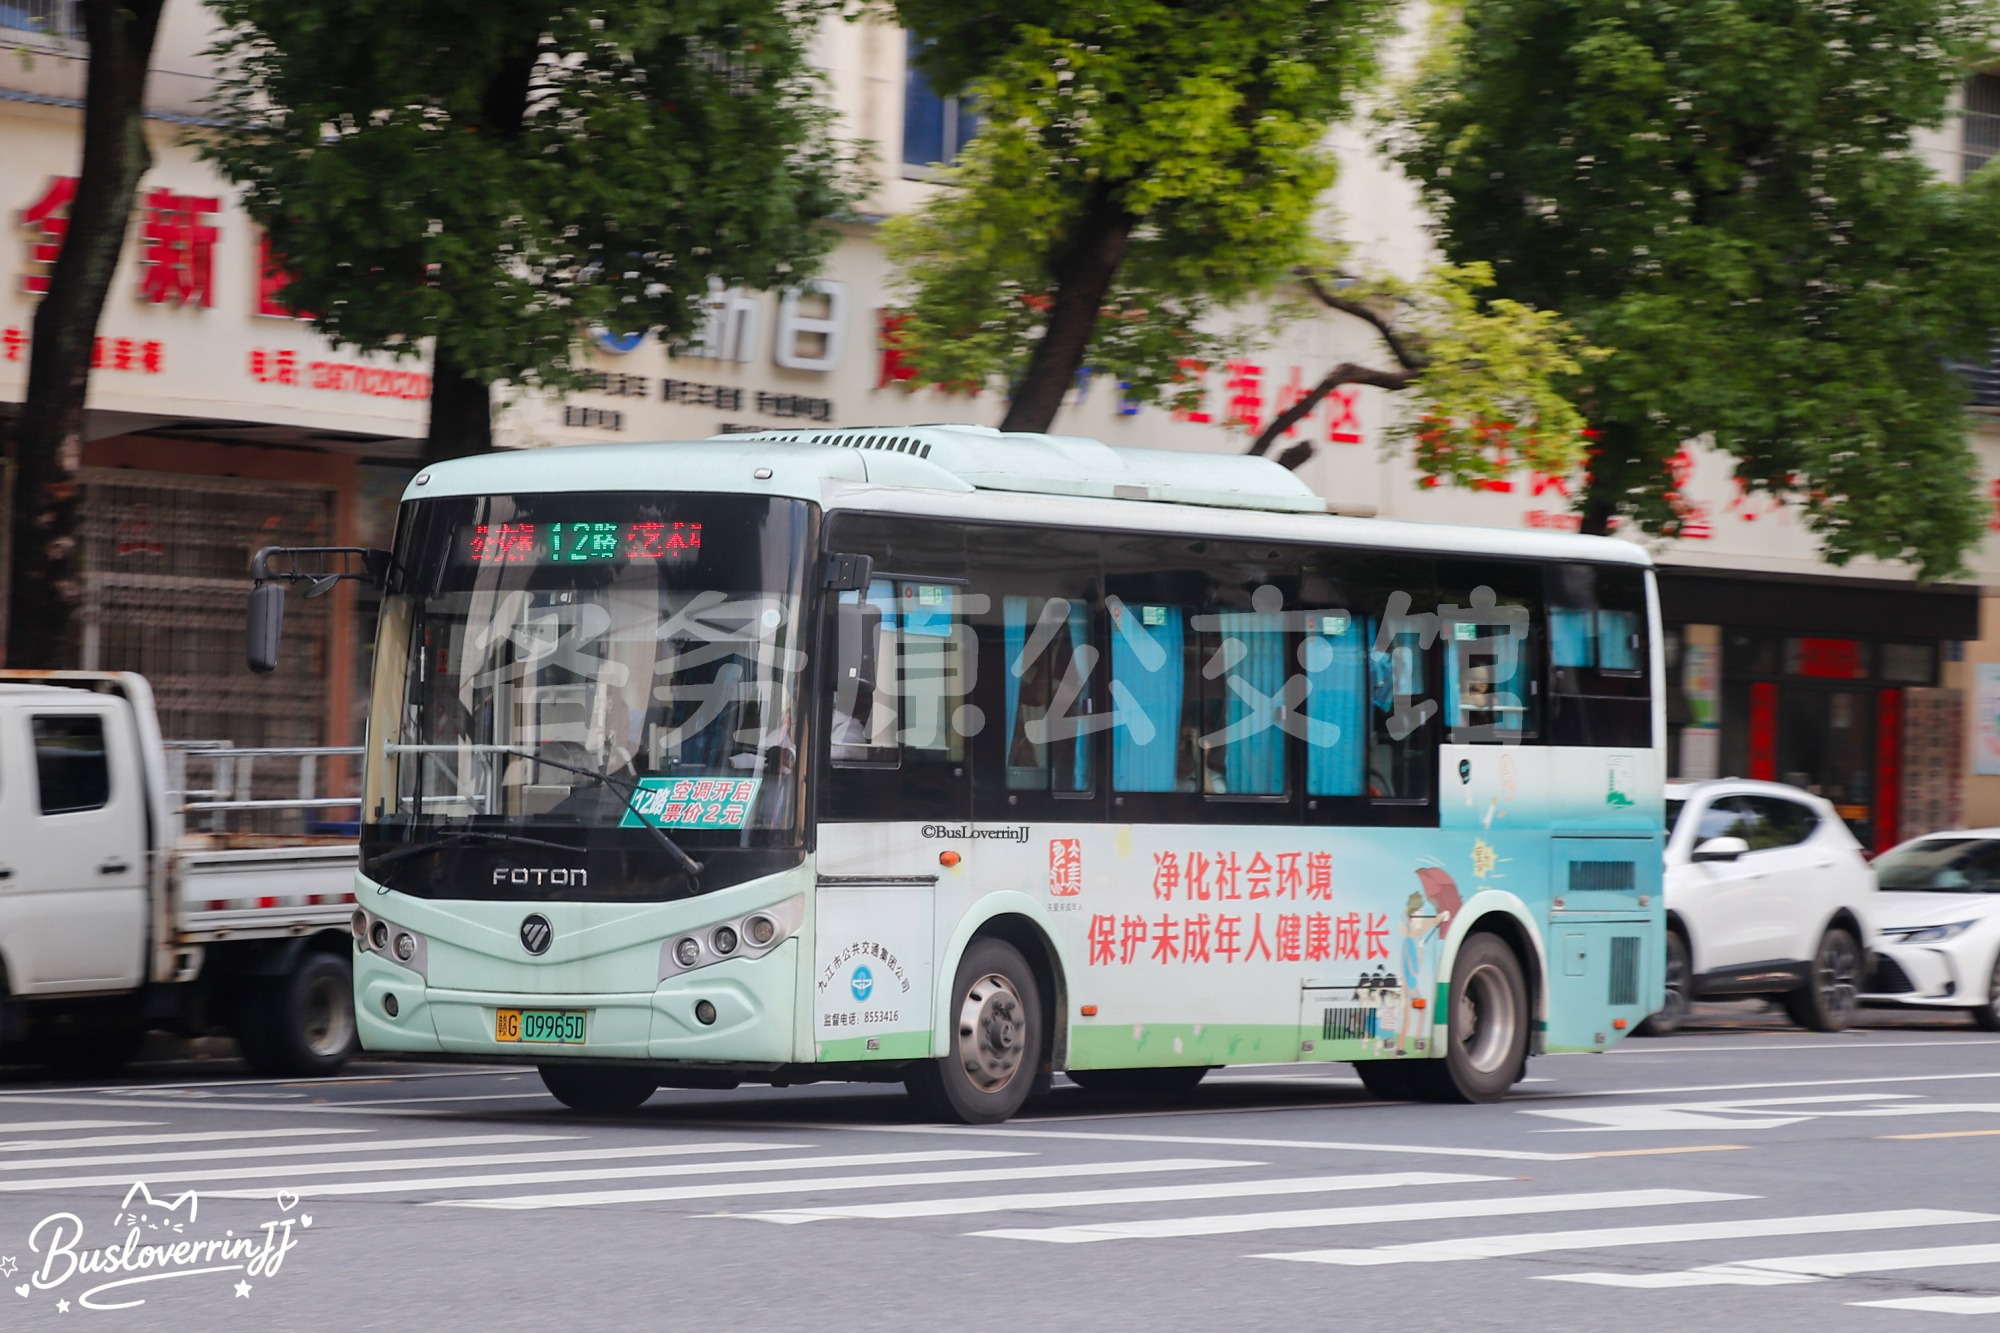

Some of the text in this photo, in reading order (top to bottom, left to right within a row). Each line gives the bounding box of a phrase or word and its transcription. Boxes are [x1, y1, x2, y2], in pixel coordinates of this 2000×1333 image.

[552, 522, 618, 560] 12路
[670, 781, 754, 802] 空调开启
[660, 803, 744, 825] 票价2元
[493, 867, 588, 887] FOTON
[1153, 850, 1332, 902] 净化社会环境
[1087, 911, 1390, 967] 保护未成年人健康成长
[817, 940, 911, 995] 九江市公共交通集团公司
